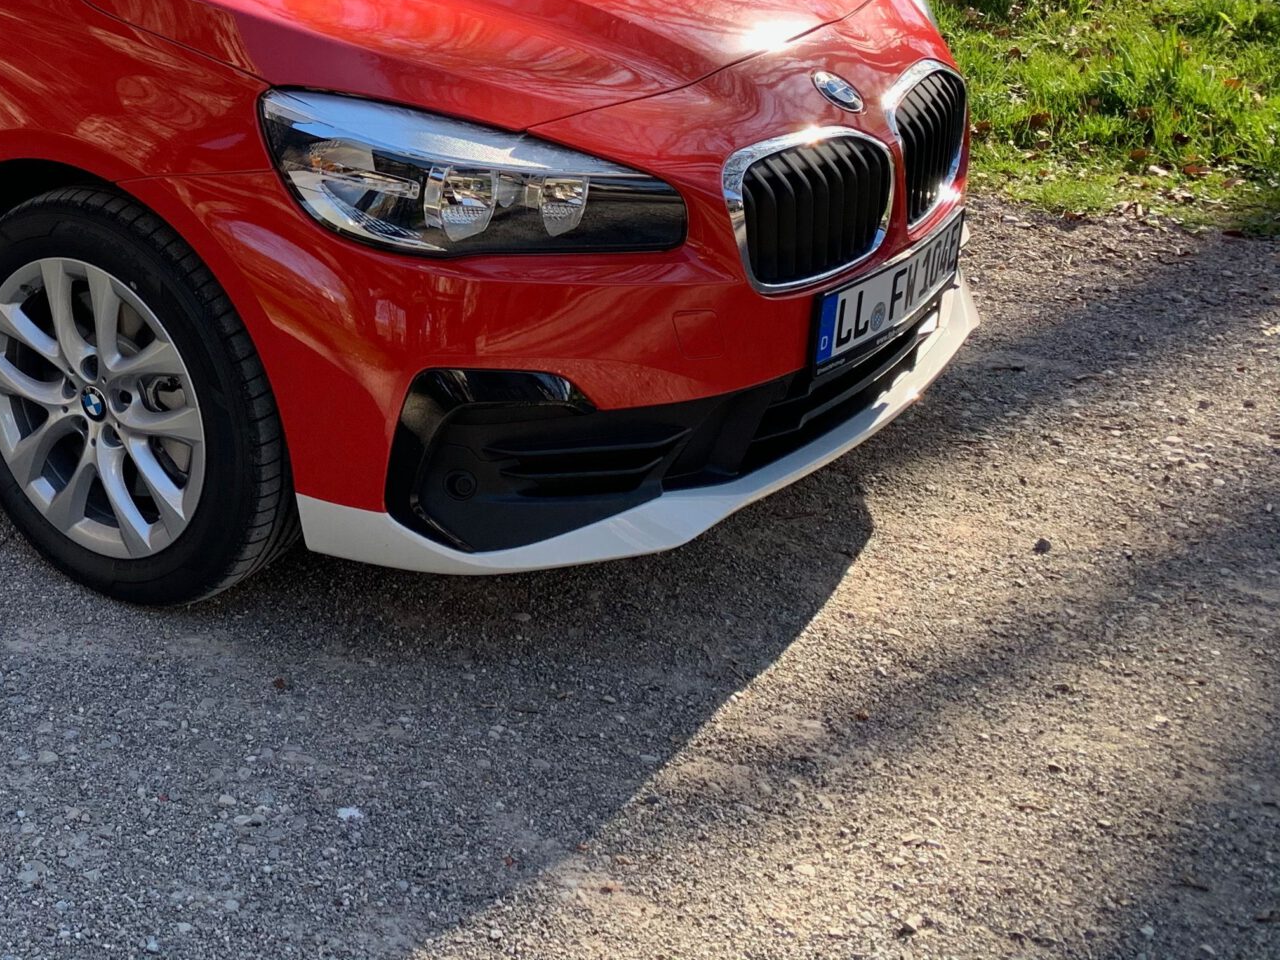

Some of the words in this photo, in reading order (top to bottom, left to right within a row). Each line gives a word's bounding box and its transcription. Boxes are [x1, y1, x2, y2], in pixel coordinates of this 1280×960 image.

[835, 290, 870, 348] LL
[888, 257, 919, 321] FW
[820, 335, 828, 351] D
